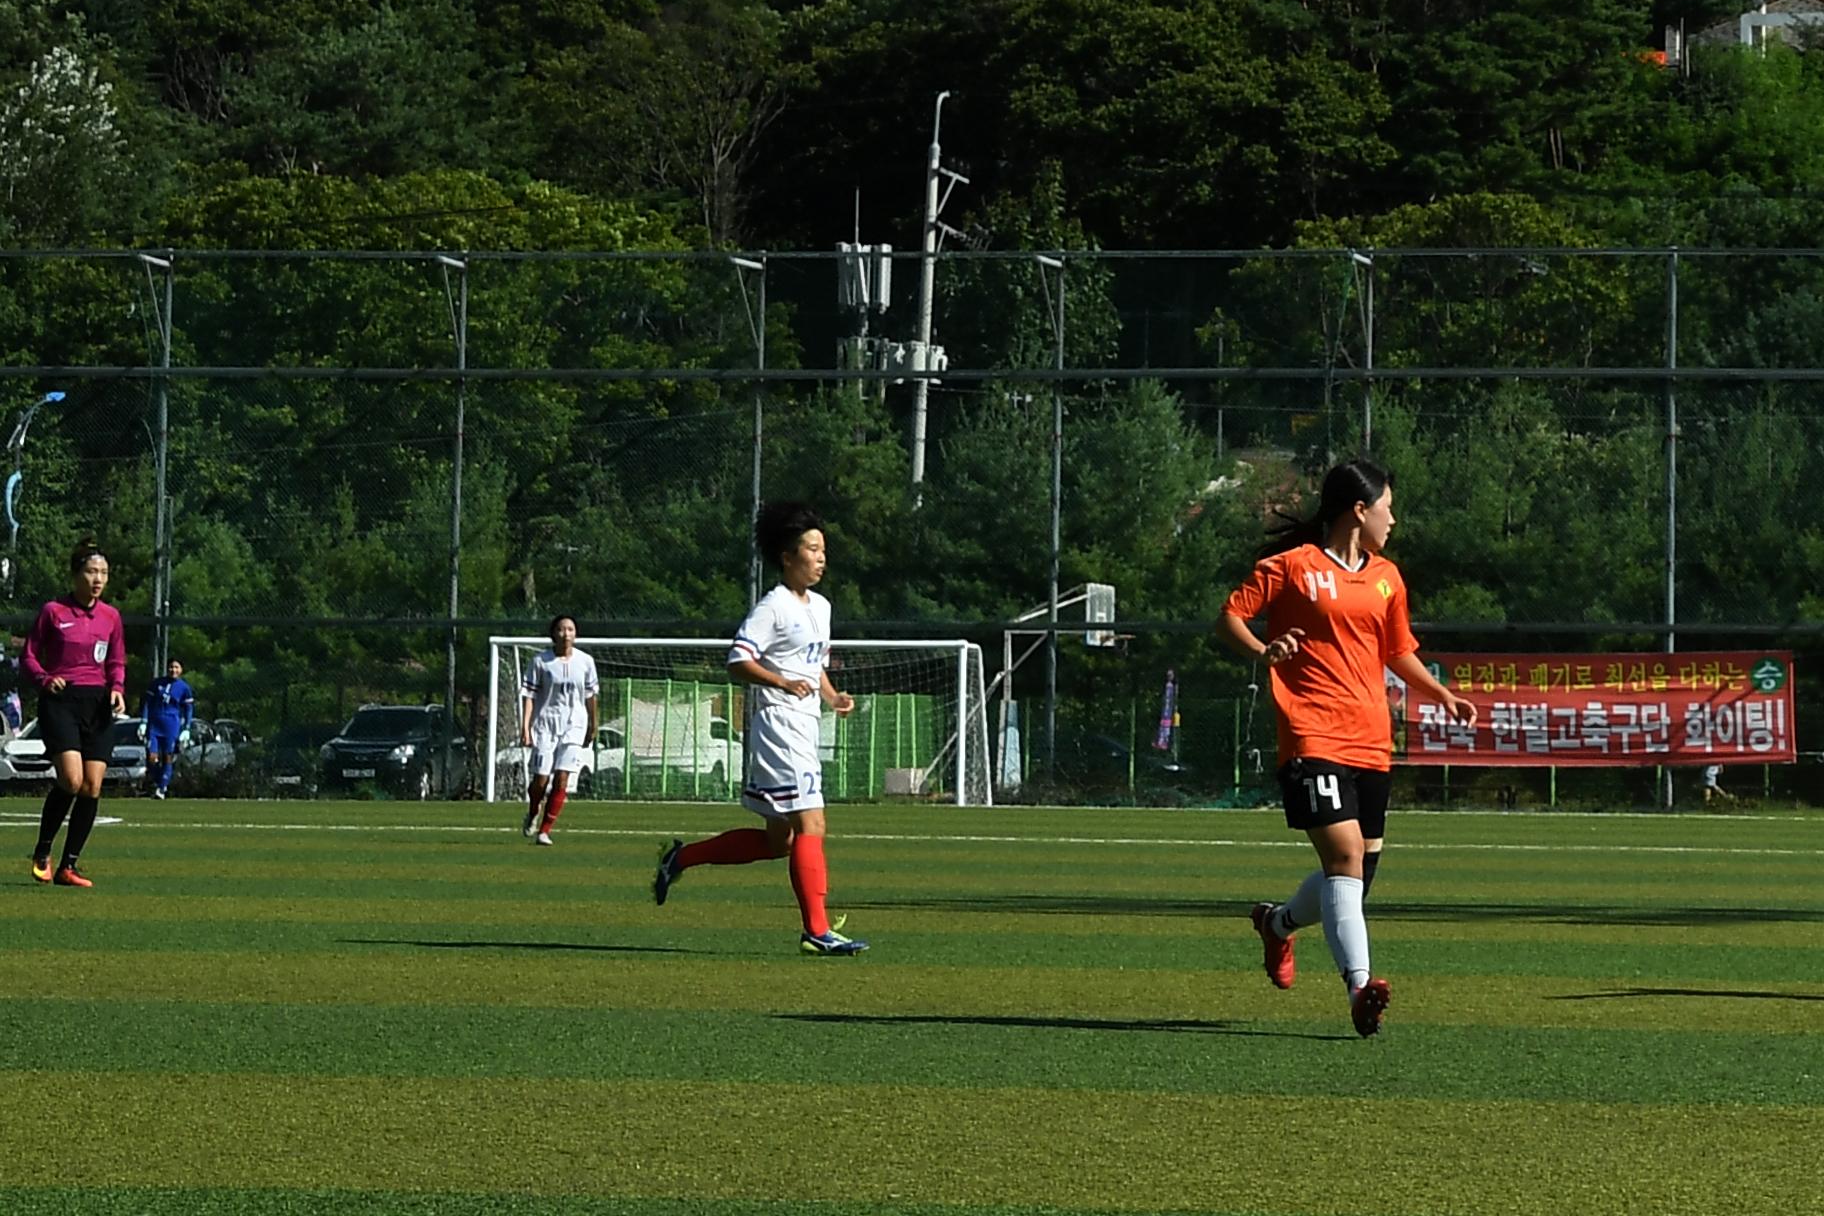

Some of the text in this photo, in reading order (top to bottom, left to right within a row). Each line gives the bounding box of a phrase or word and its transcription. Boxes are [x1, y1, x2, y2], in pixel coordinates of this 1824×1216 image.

[1303, 570, 1338, 601] 14
[1454, 662, 1520, 693] 열정과
[1529, 662, 1596, 694] 패기로
[1604, 662, 1671, 693] 최선을
[1679, 661, 1747, 692] 다하는
[1753, 660, 1783, 690] 승
[1490, 702, 1671, 753] 한별고축구단
[1684, 699, 1786, 753] 화이팅!
[1303, 774, 1342, 813] 14
